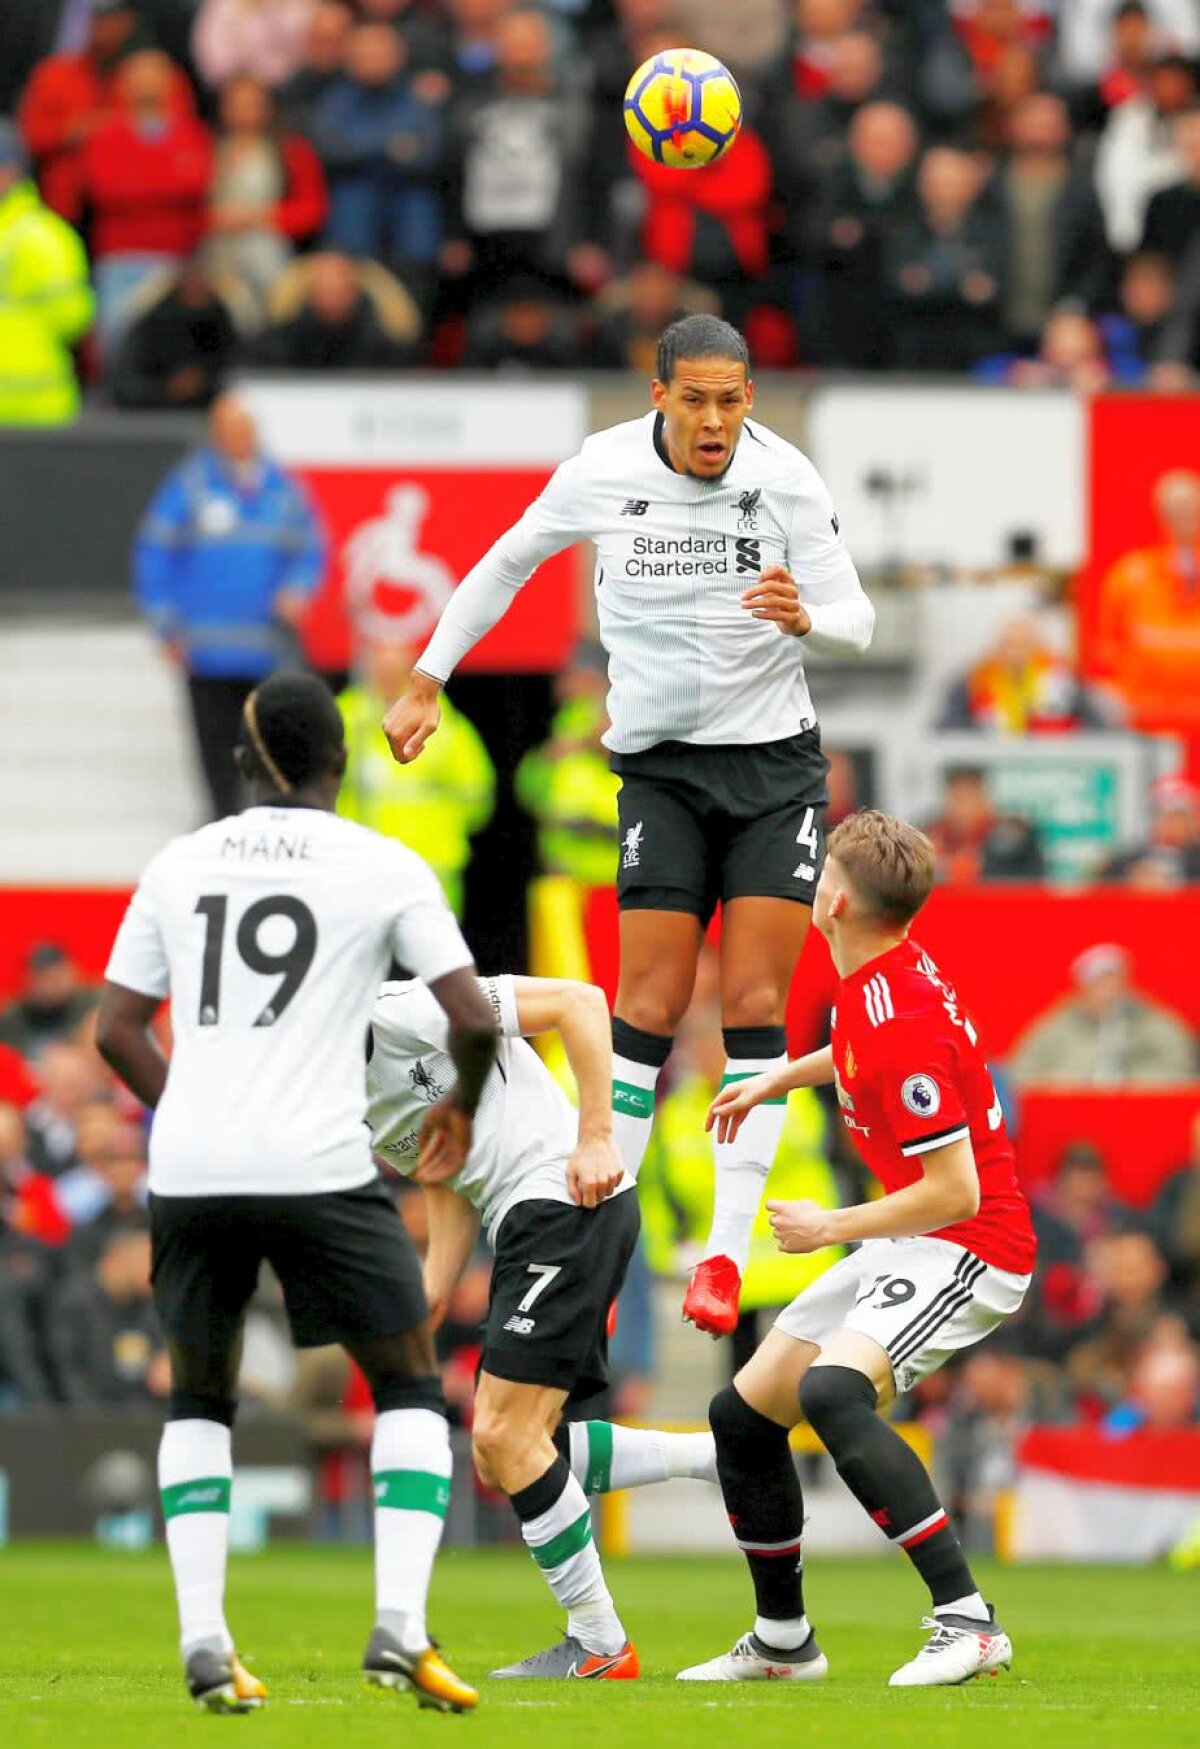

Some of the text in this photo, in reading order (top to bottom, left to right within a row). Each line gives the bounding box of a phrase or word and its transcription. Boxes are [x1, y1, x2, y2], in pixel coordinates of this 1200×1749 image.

[625, 558, 727, 577] Chartered
[633, 537, 727, 555] Standard
[795, 806, 818, 860] 4
[194, 893, 318, 1028] 19
[517, 1262, 562, 1313] 7
